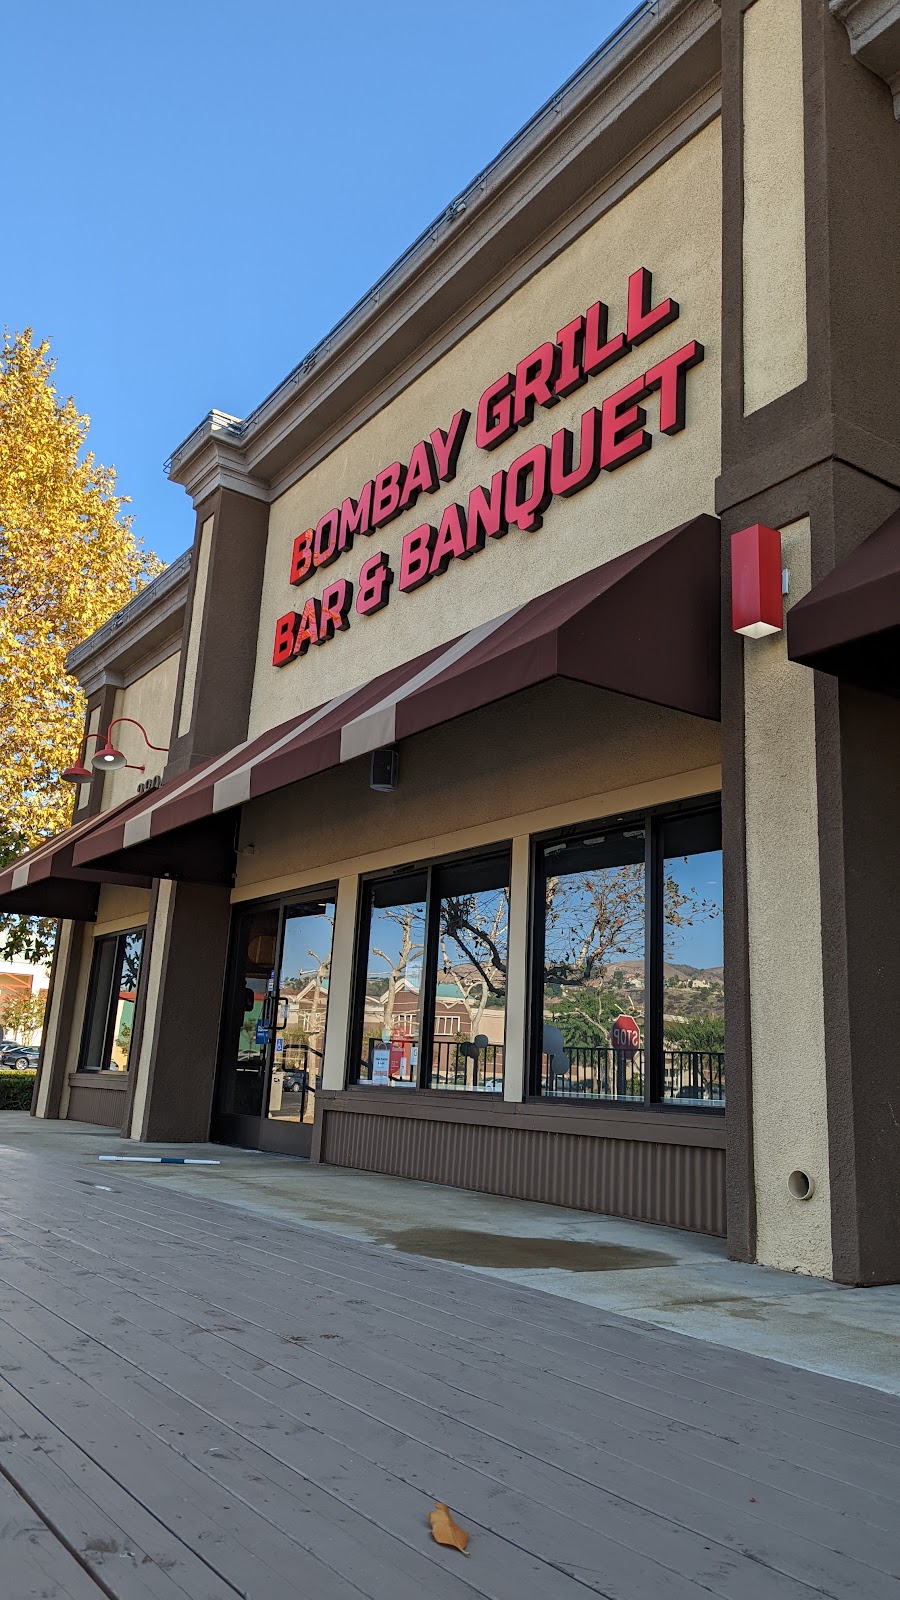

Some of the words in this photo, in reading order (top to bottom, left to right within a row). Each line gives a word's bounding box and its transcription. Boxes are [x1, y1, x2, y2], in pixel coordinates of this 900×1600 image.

[273, 579, 353, 667] BAR
[356, 551, 393, 616] &
[399, 340, 704, 593] BANQUET
[289, 409, 470, 586] BOMBAY
[477, 267, 679, 451] GRILL
